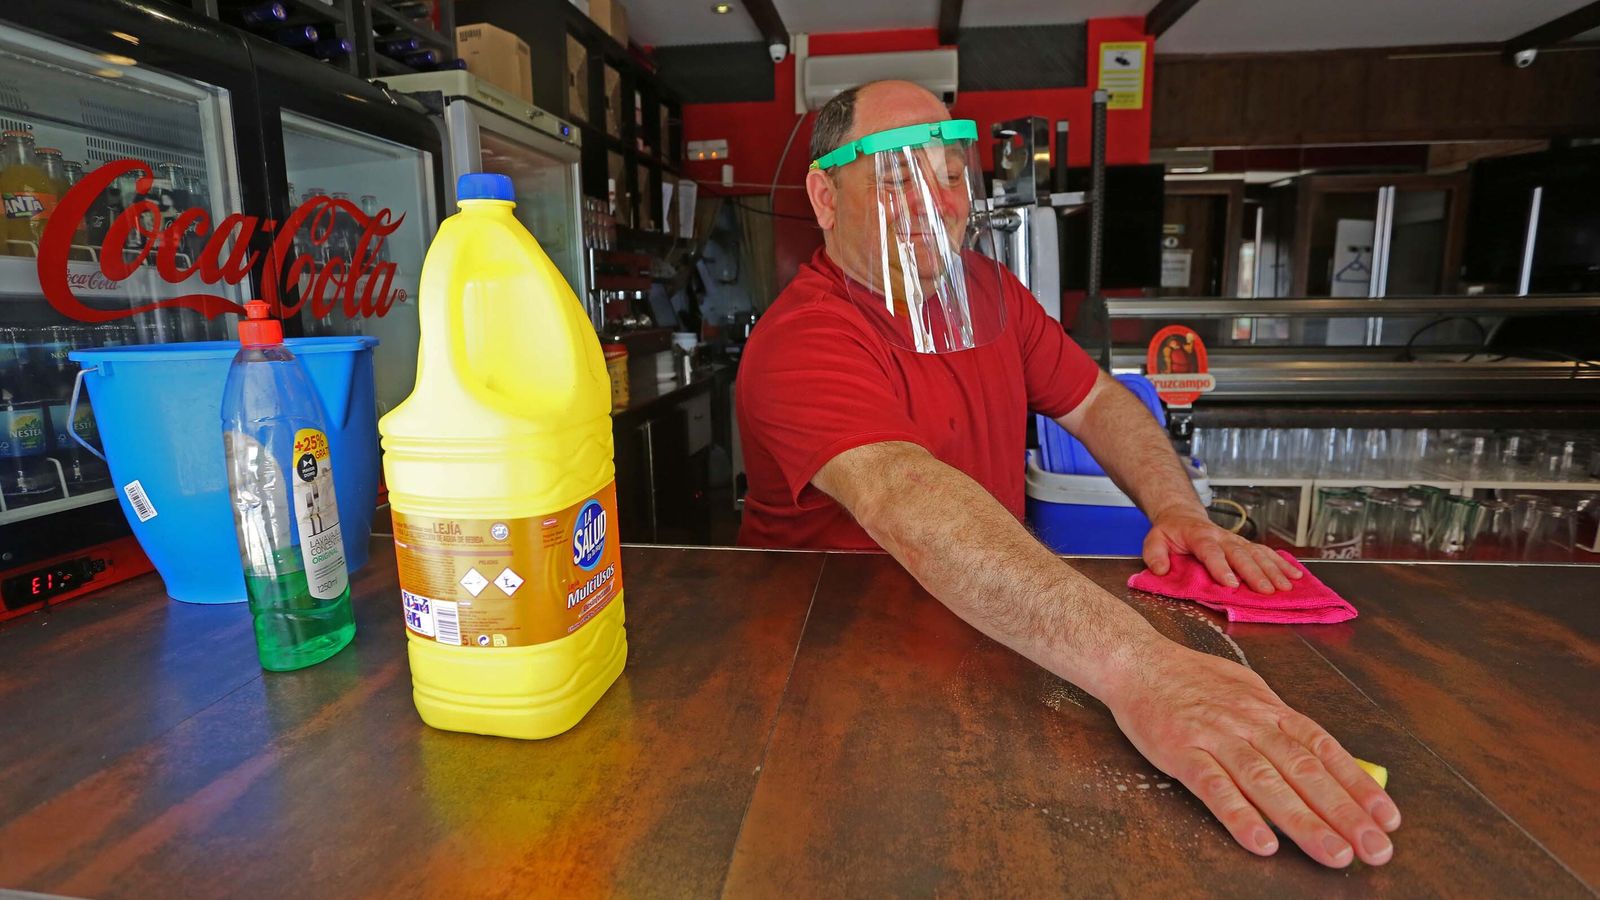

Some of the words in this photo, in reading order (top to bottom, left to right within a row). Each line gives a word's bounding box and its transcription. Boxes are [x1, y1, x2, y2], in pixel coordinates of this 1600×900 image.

[4, 194, 44, 214] ANTA
[66, 270, 118, 290] oca-Cola
[1153, 379, 1211, 389] ruzcampo
[294, 433, 325, 452] +25%
[584, 508, 592, 527] LA
[432, 521, 462, 535] LEJÍA
[573, 510, 607, 565] SALUD
